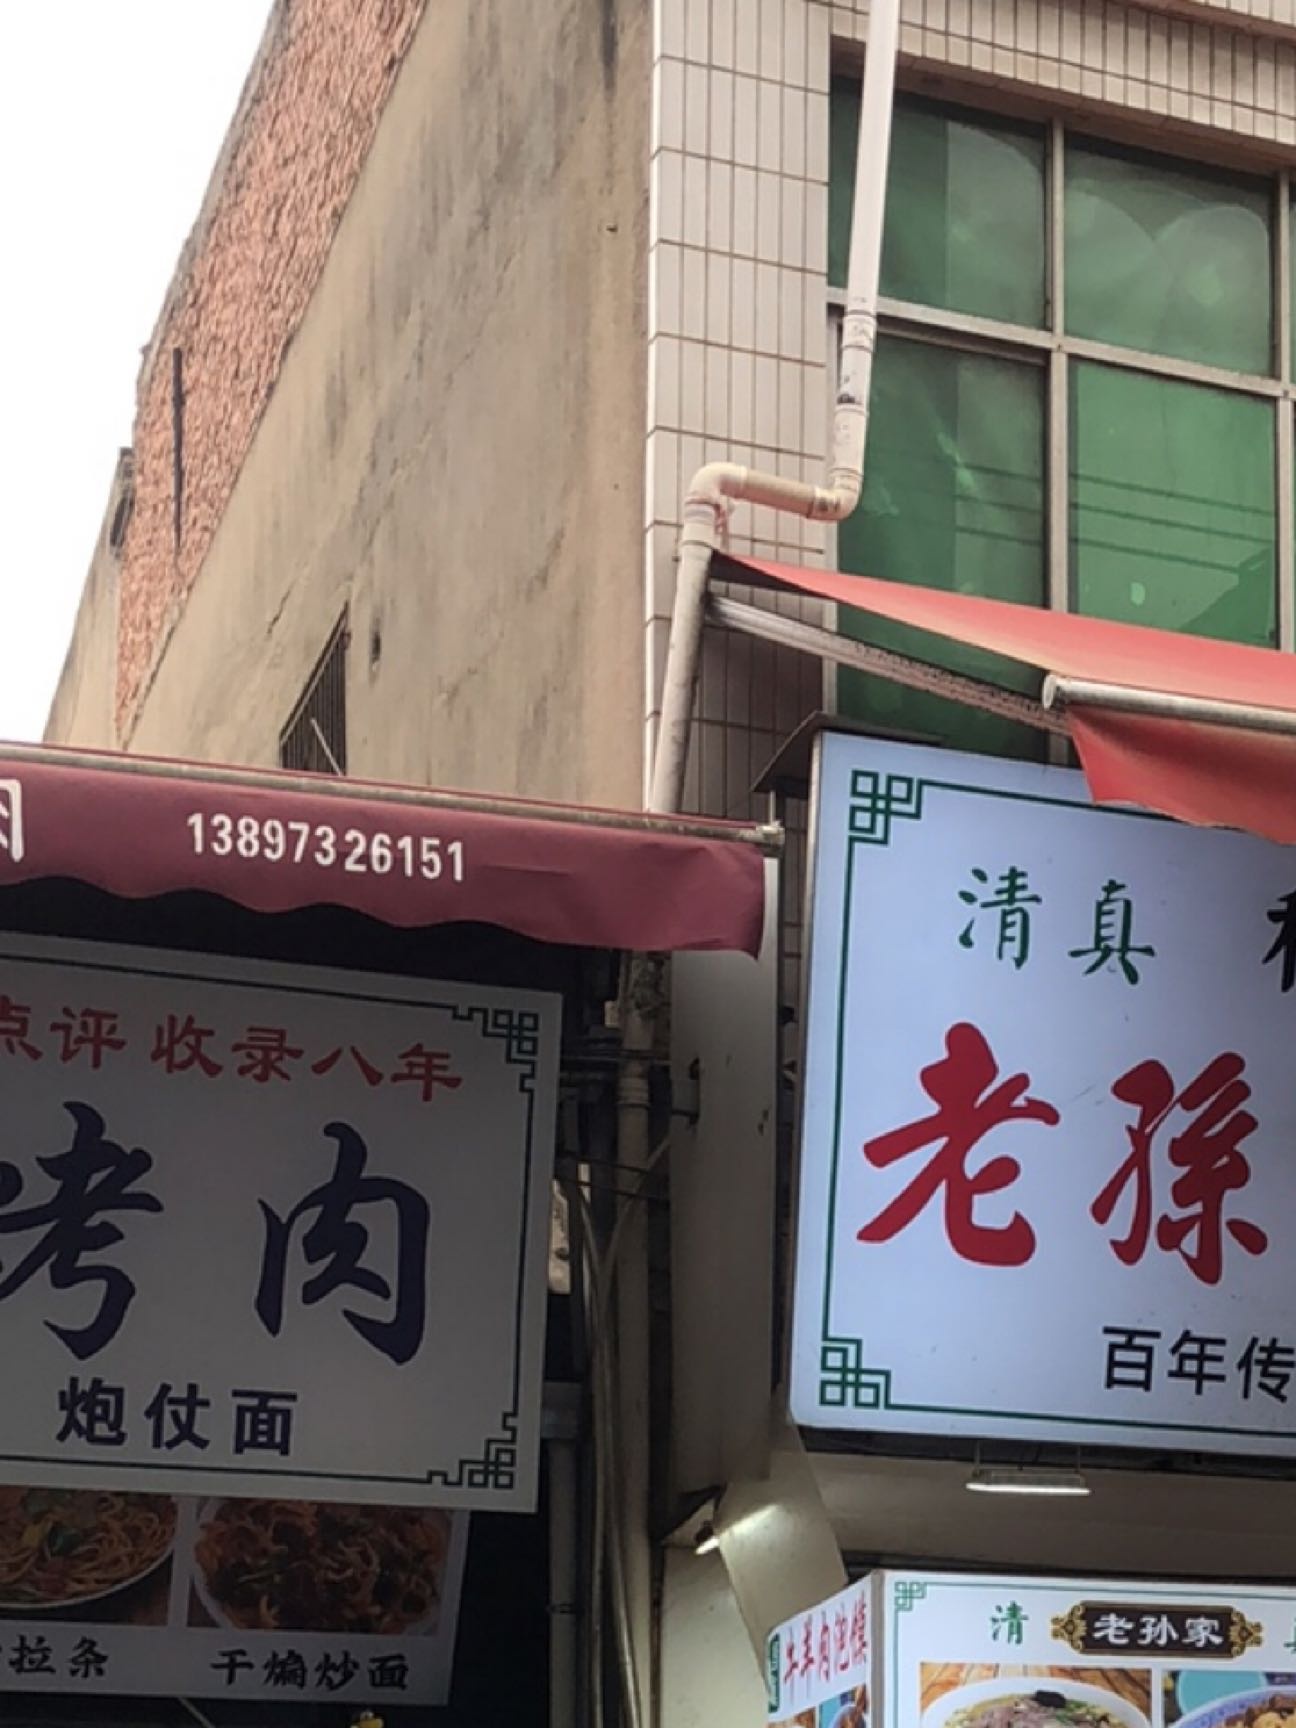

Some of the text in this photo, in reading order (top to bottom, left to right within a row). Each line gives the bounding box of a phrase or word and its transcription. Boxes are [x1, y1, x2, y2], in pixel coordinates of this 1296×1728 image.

[188, 812, 466, 882] 13897326151
[957, 865, 1157, 987] 清真
[0, 1102, 430, 1364] 烤肉
[57, 1377, 297, 1456] 炮仗面
[0, 1635, 409, 1690] 拉条 干煸炒面
[989, 1603, 1029, 1646] 清
[1093, 1614, 1226, 1648] 老孙家
